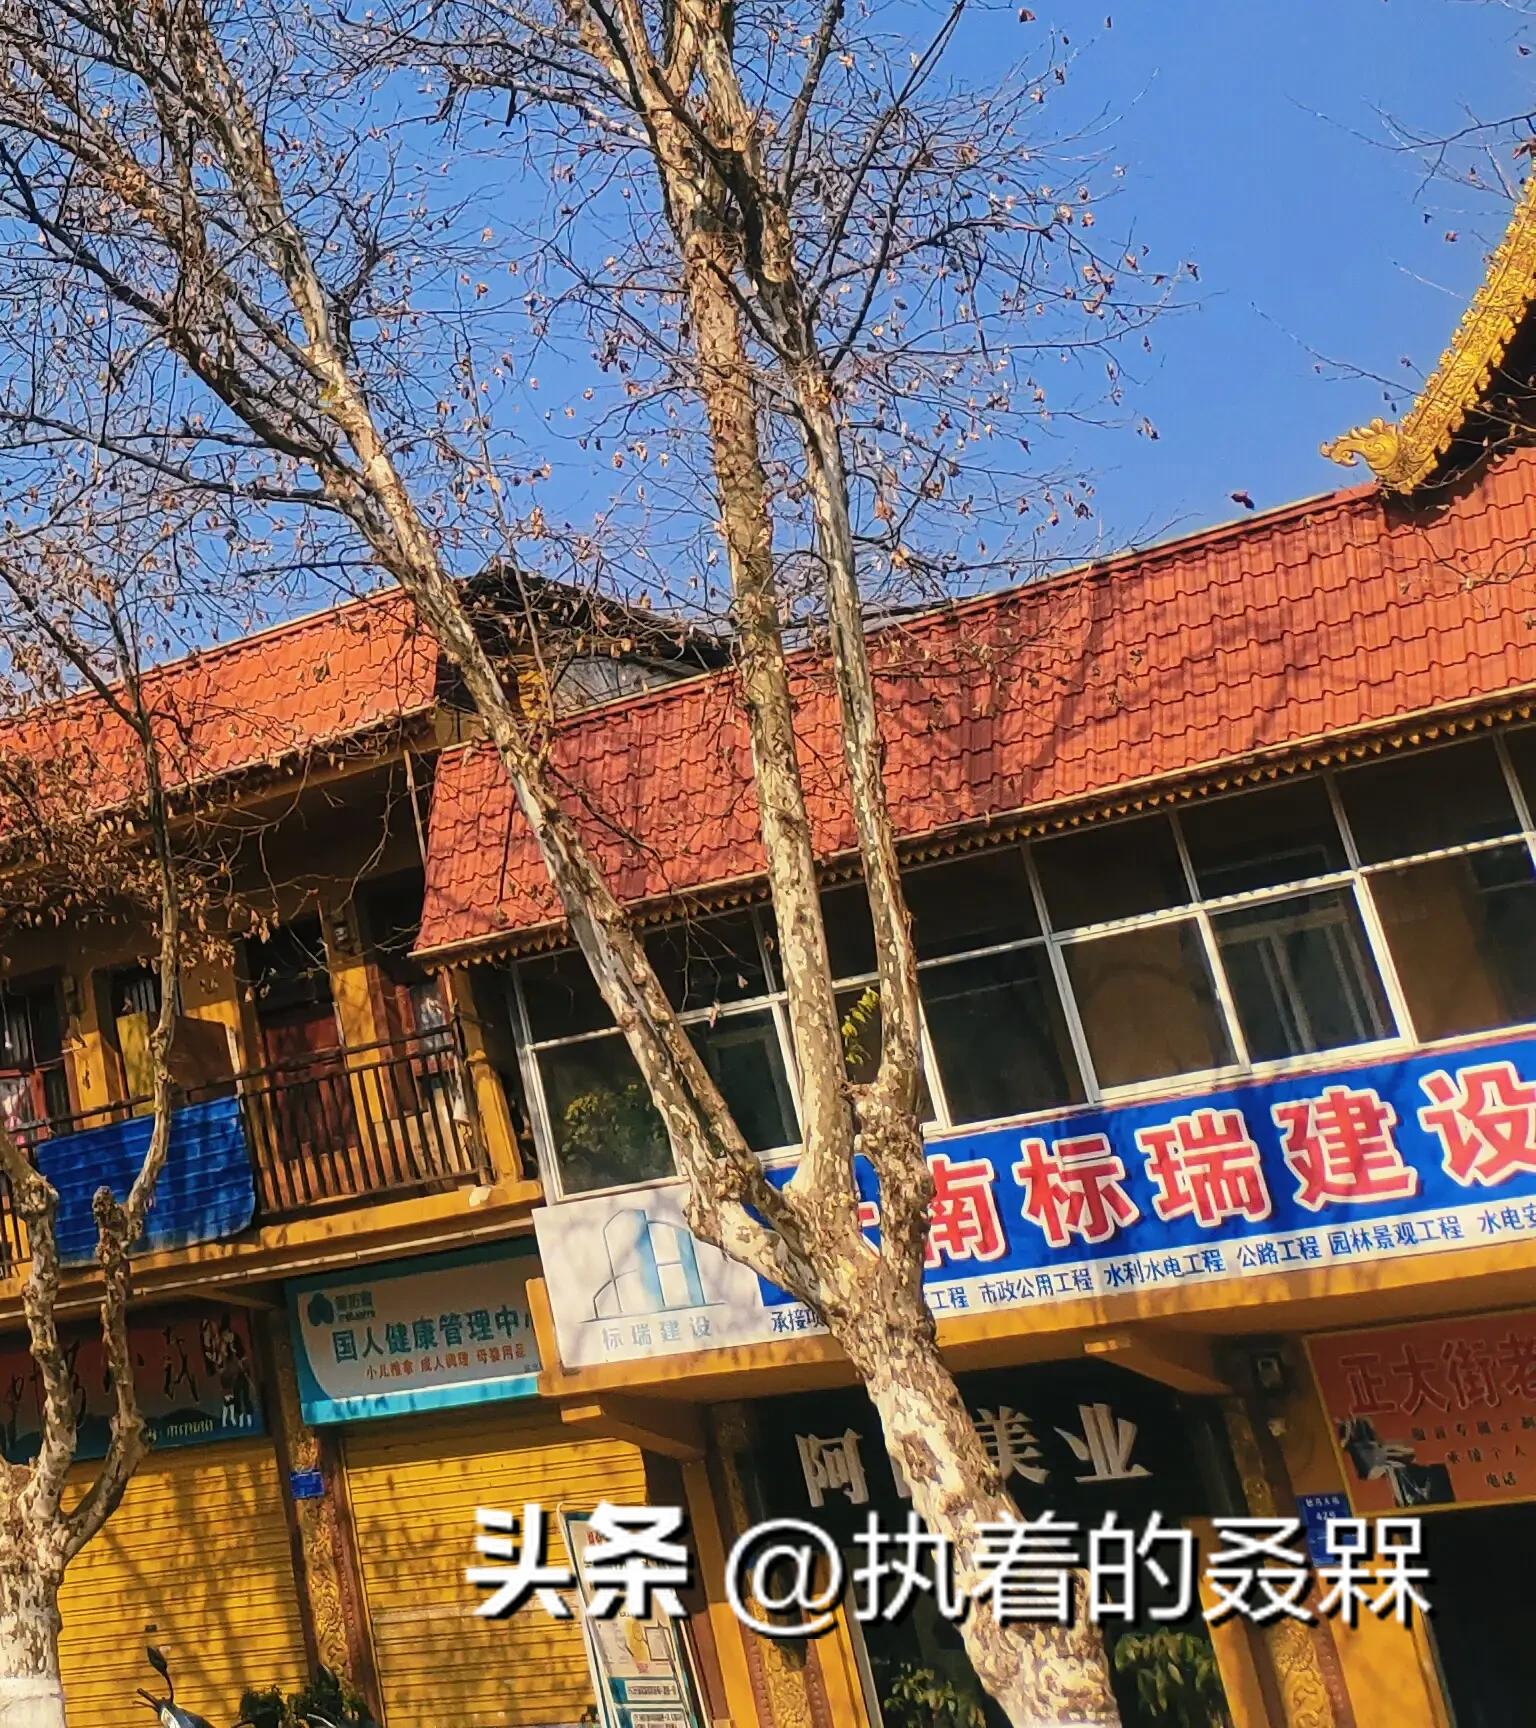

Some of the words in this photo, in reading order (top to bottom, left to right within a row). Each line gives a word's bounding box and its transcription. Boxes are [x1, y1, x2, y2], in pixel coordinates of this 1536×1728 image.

[858, 1061, 1536, 1268] 南标瑞建设
[981, 1267, 1094, 1305] 市政公用工程
[1103, 1248, 1226, 1288] 水利水电工程
[1236, 1235, 1322, 1268] 公路工程
[1327, 1215, 1465, 1255] 园林景观工程
[333, 1304, 532, 1364] 国人健康管理中
[602, 1315, 713, 1351] 标瑞建设
[794, 1403, 1153, 1508] 阿美业
